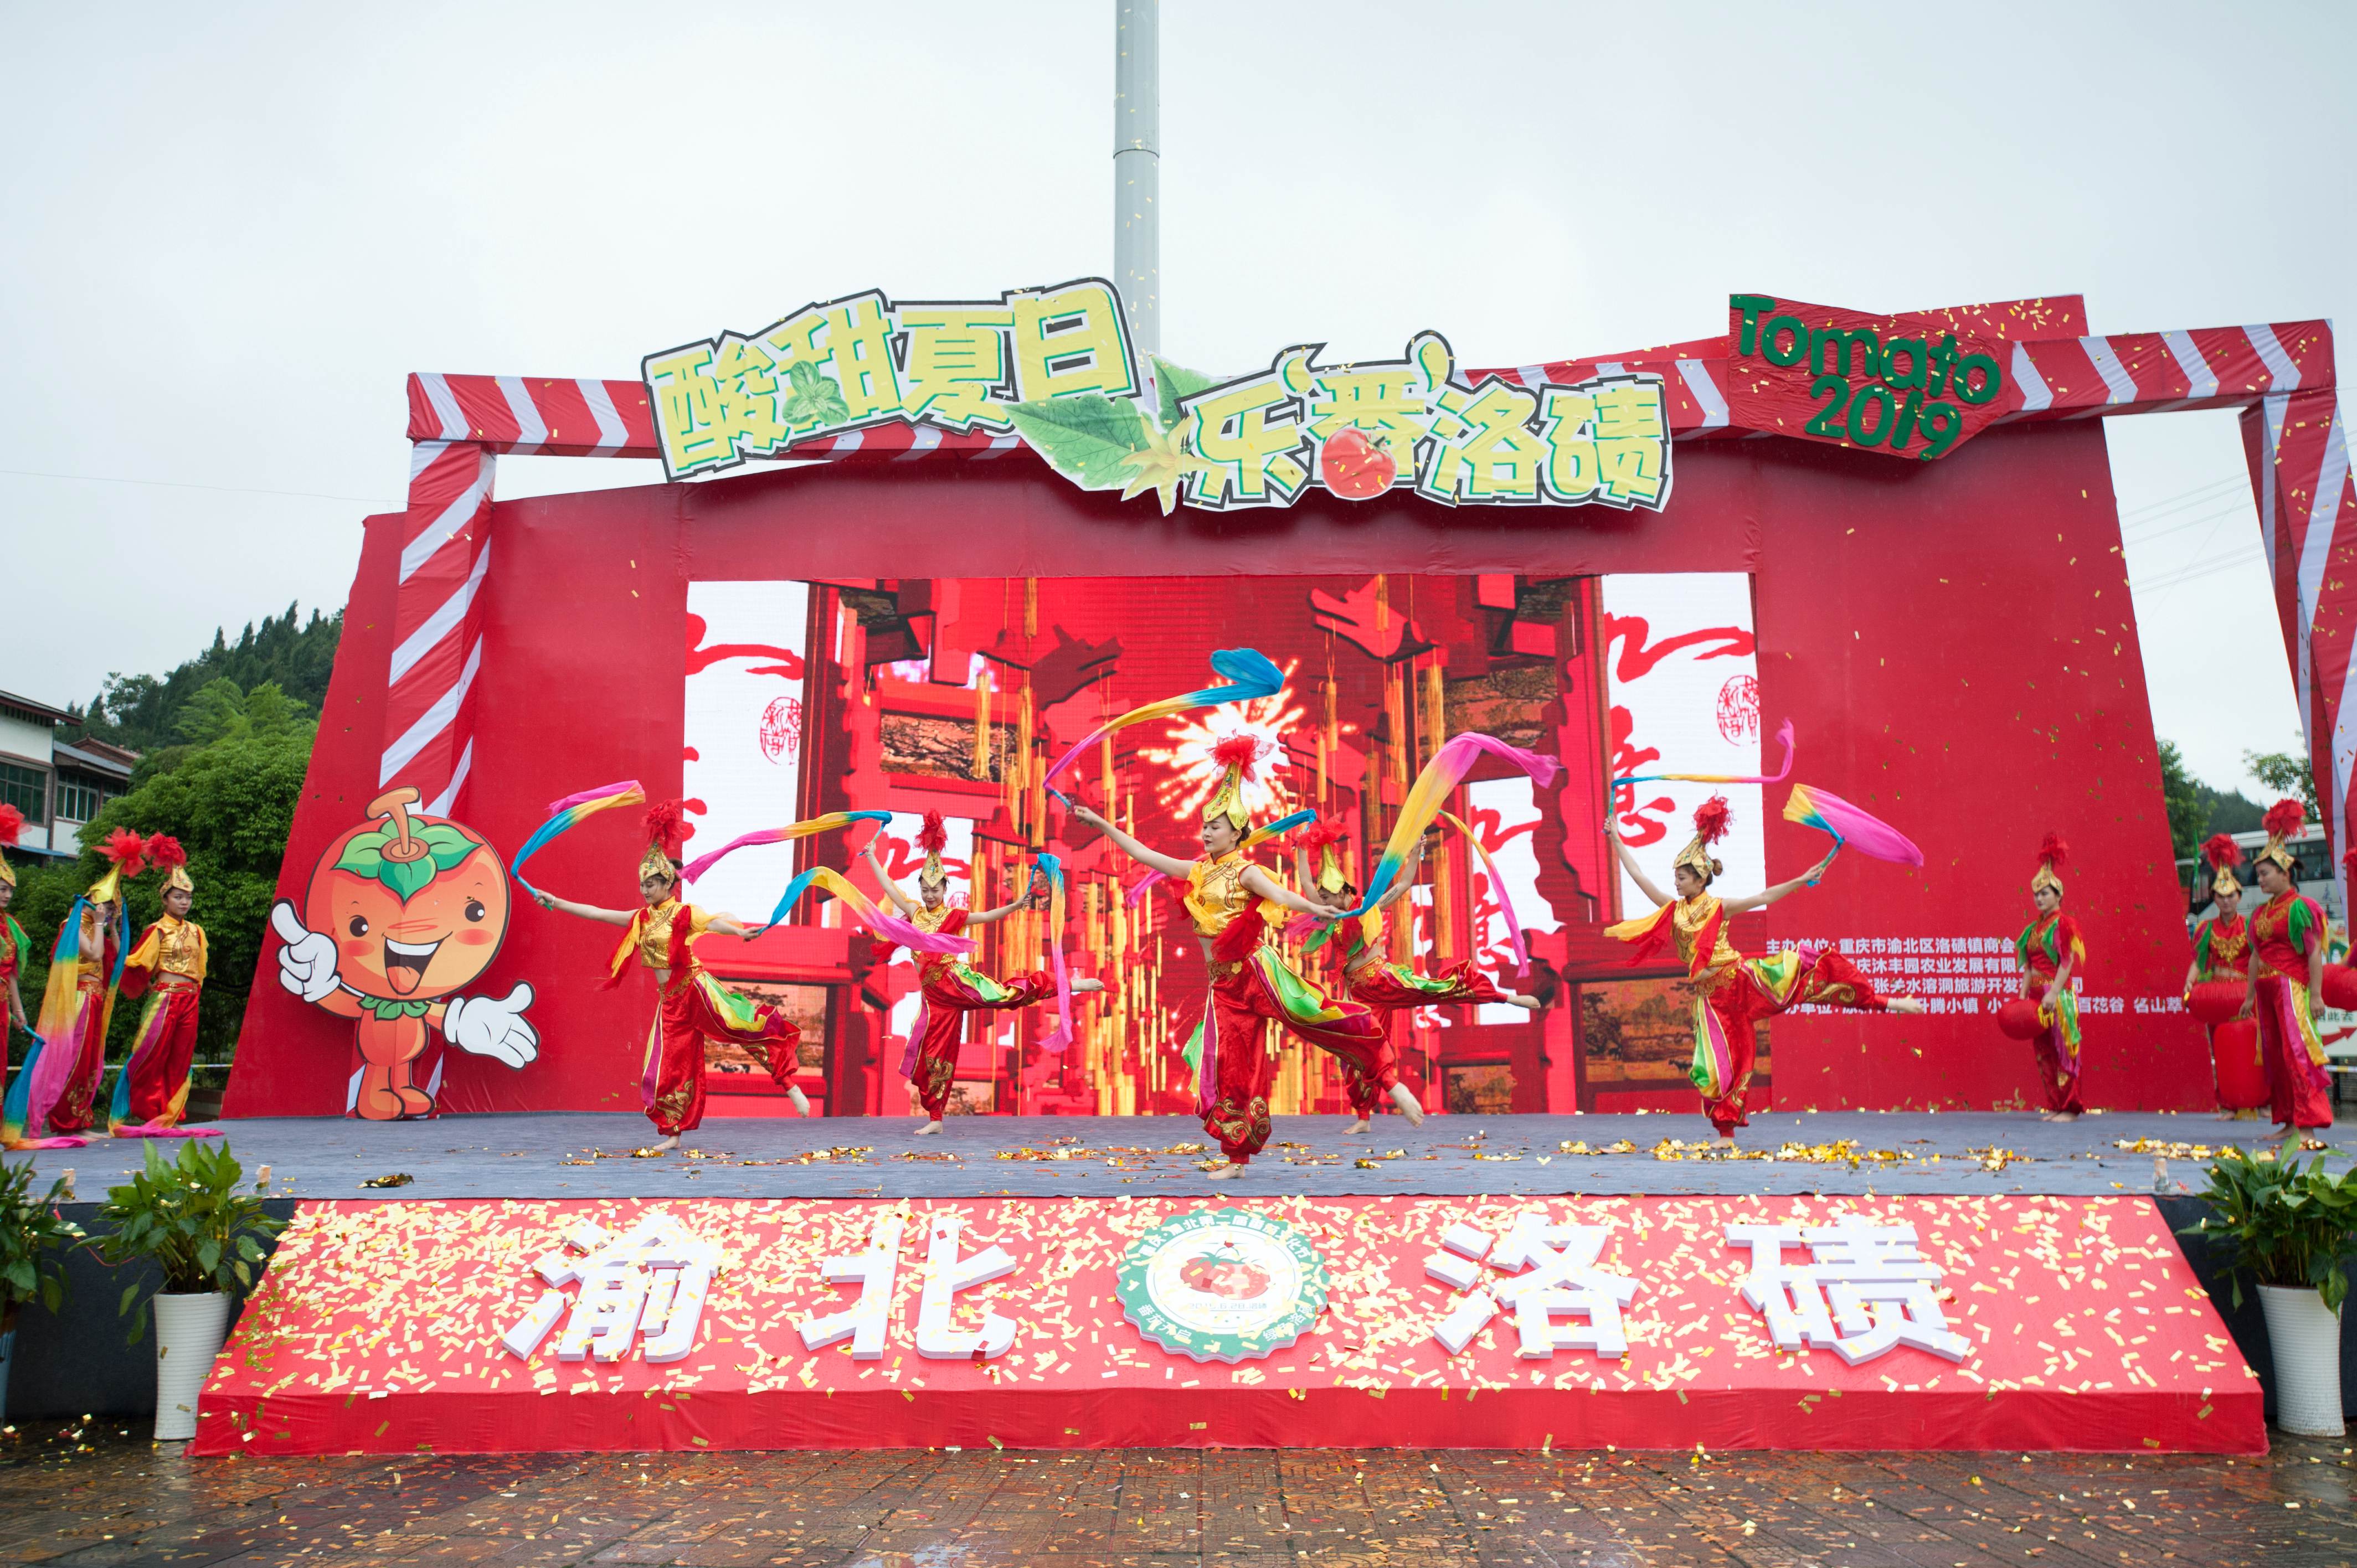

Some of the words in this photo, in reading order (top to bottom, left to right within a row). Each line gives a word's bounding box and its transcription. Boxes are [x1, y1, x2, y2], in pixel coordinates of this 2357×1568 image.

[651, 287, 1131, 472] 酸甜夏日
[1730, 295, 2001, 405] Tomato
[1804, 374, 1962, 462] 2019
[1847, 957, 2026, 974] 庆沐丰园农业发展有限
